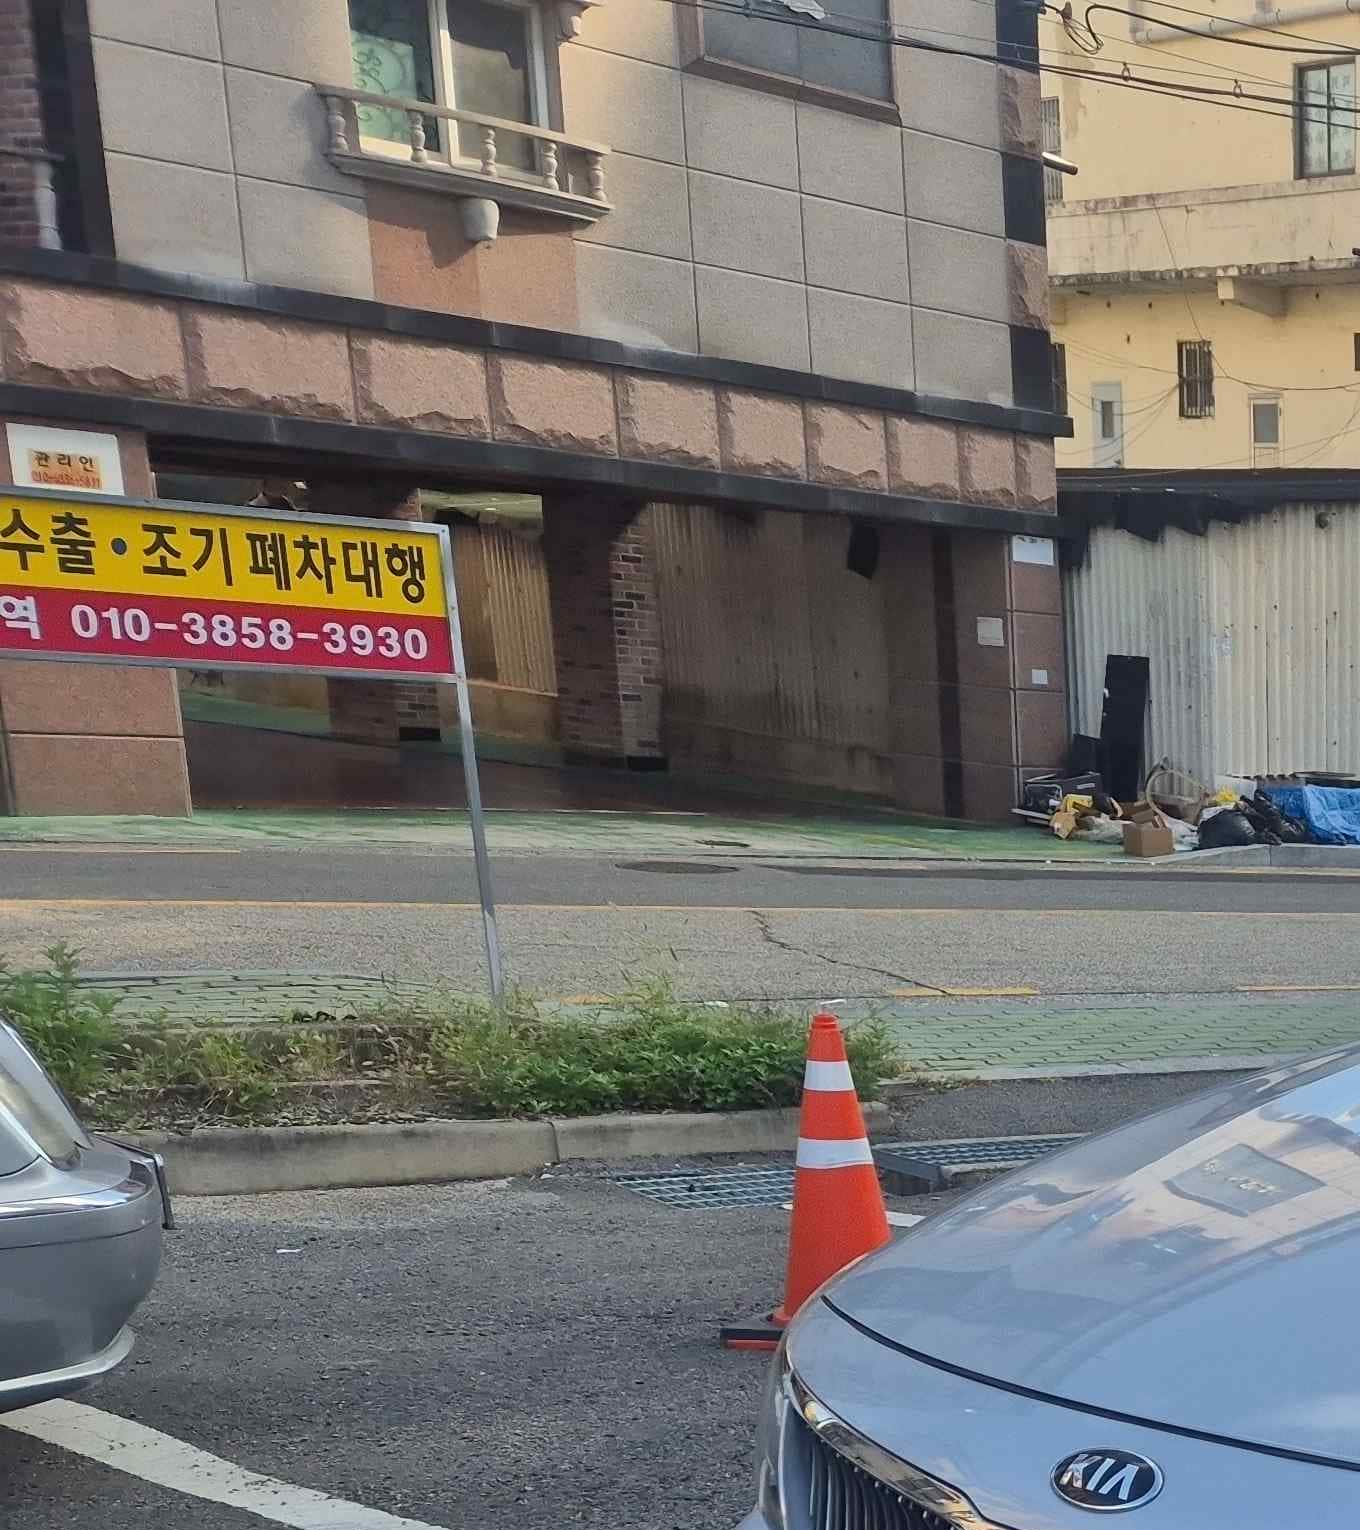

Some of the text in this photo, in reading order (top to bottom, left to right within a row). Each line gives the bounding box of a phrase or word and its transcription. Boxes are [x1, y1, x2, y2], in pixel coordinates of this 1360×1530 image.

[245, 531, 427, 604] 폐차대행
[71, 603, 429, 660] 010-3858-3930
[1059, 1453, 1139, 1501] KIA
